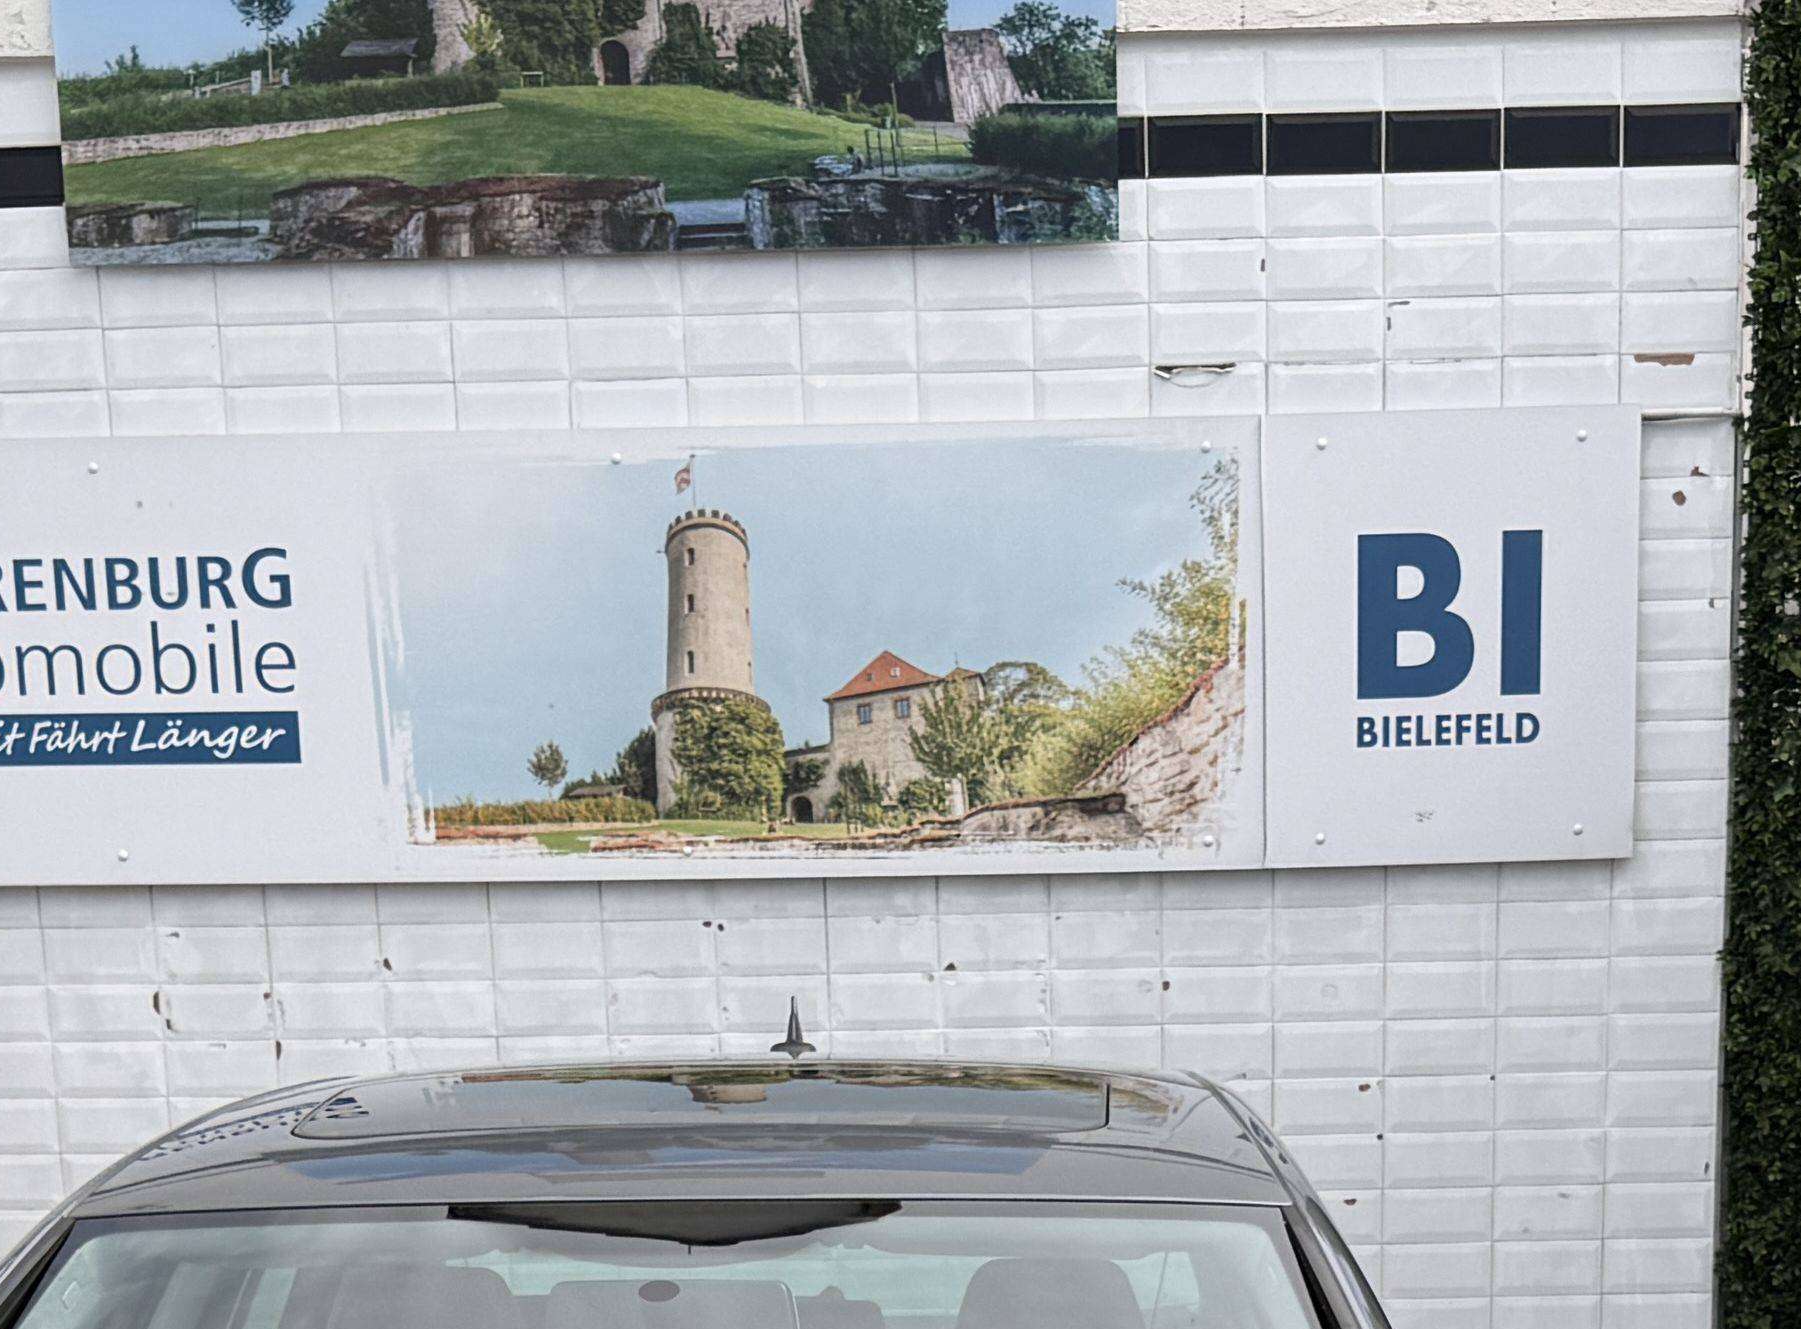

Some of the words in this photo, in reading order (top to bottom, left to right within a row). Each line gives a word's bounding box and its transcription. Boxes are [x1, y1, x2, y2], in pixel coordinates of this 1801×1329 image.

[1357, 529, 1543, 700] BI
[29, 721, 127, 755] Fährt
[131, 719, 286, 759] Länger
[1357, 712, 1540, 748] BIELEFELD
